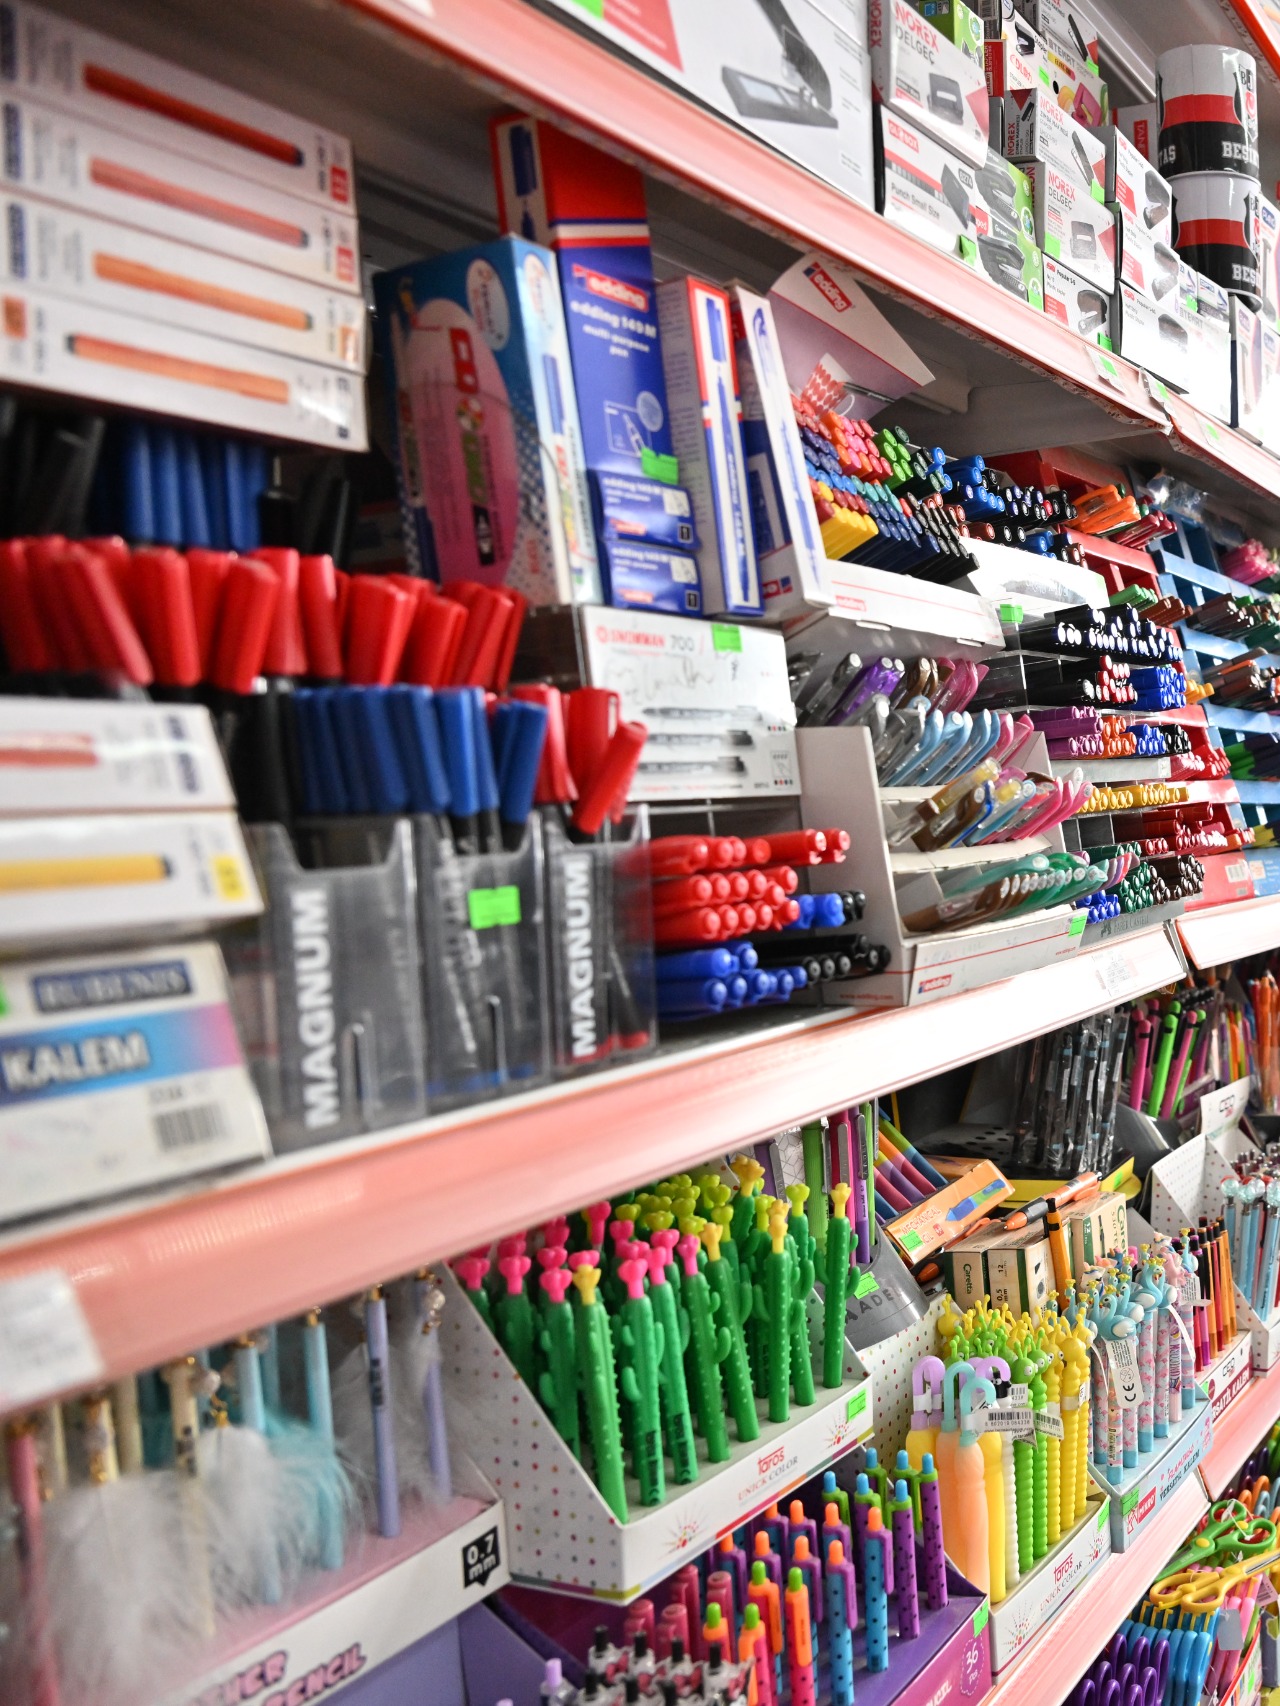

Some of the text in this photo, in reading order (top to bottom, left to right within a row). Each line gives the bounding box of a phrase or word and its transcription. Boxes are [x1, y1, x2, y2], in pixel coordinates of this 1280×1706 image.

[895, 2, 939, 54] NOREX
[1040, 96, 1064, 126] NOREX
[1007, 122, 1016, 156] NOREX
[891, 181, 941, 218] Punch Small Size
[1048, 170, 1076, 201] NOREX
[1048, 185, 1073, 211] DELGEÇ
[589, 276, 646, 311] edding
[814, 273, 849, 312] edding
[570, 300, 620, 329] edding
[609, 345, 629, 359] pen
[610, 629, 695, 652] SNOWMAN 700
[564, 859, 598, 1057] MAGNUM
[924, 975, 952, 990] edding
[290, 888, 341, 1130] MAGNUM
[2, 1030, 150, 1093] KALEM
[900, 1206, 942, 1236] MECHANICAL
[962, 1263, 972, 1295] Caretta
[768, 1455, 799, 1481] COLOR
[466, 1533, 496, 1565] 0.7
[468, 1552, 497, 1581] mm
[1061, 1560, 1083, 1588] COLOR
[966, 1642, 979, 1674] 36
